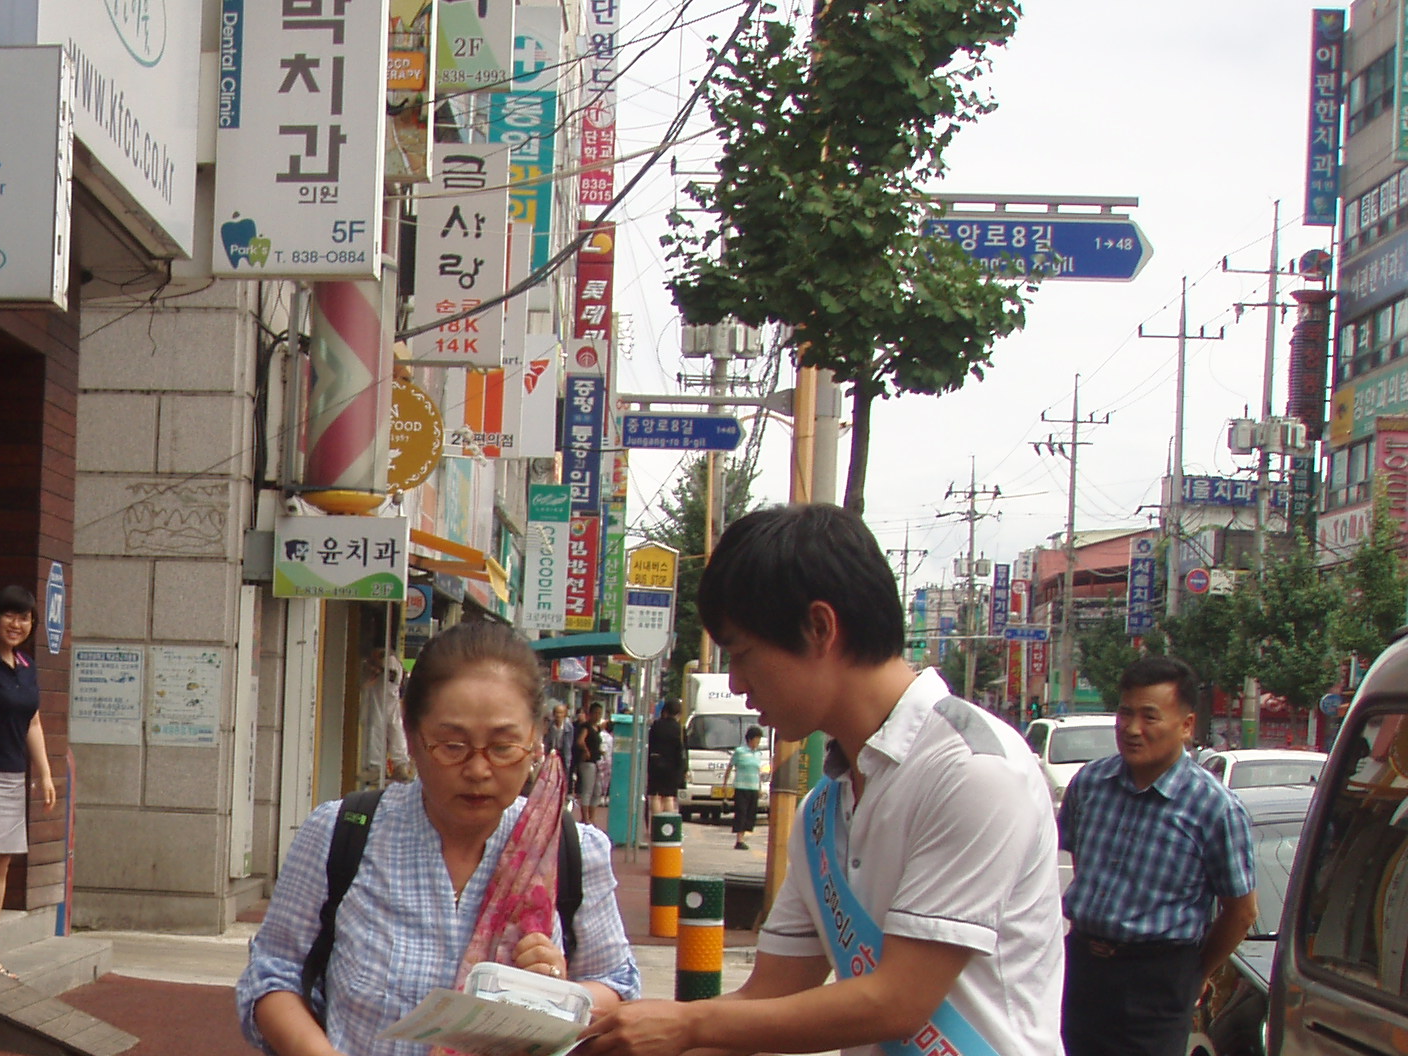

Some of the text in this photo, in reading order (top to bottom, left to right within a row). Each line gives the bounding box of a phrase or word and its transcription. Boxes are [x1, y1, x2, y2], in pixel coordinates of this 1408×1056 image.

[454, 37, 484, 57] 2F
[218, 12, 238, 127] Dental Clinic
[276, 0, 352, 182] 박치과
[1312, 45, 1338, 178] 이편한치과
[298, 186, 339, 205] 의원
[582, 190, 612, 201] 7015
[331, 220, 366, 243] 5F
[438, 155, 488, 289] 금사랑
[230, 244, 268, 256] Park's
[436, 339, 479, 353] 14K
[626, 418, 694, 435] 중앙로8길
[451, 433, 514, 448] 2편의점
[317, 537, 401, 568] 윤치과
[633, 561, 669, 573] 시내버스
